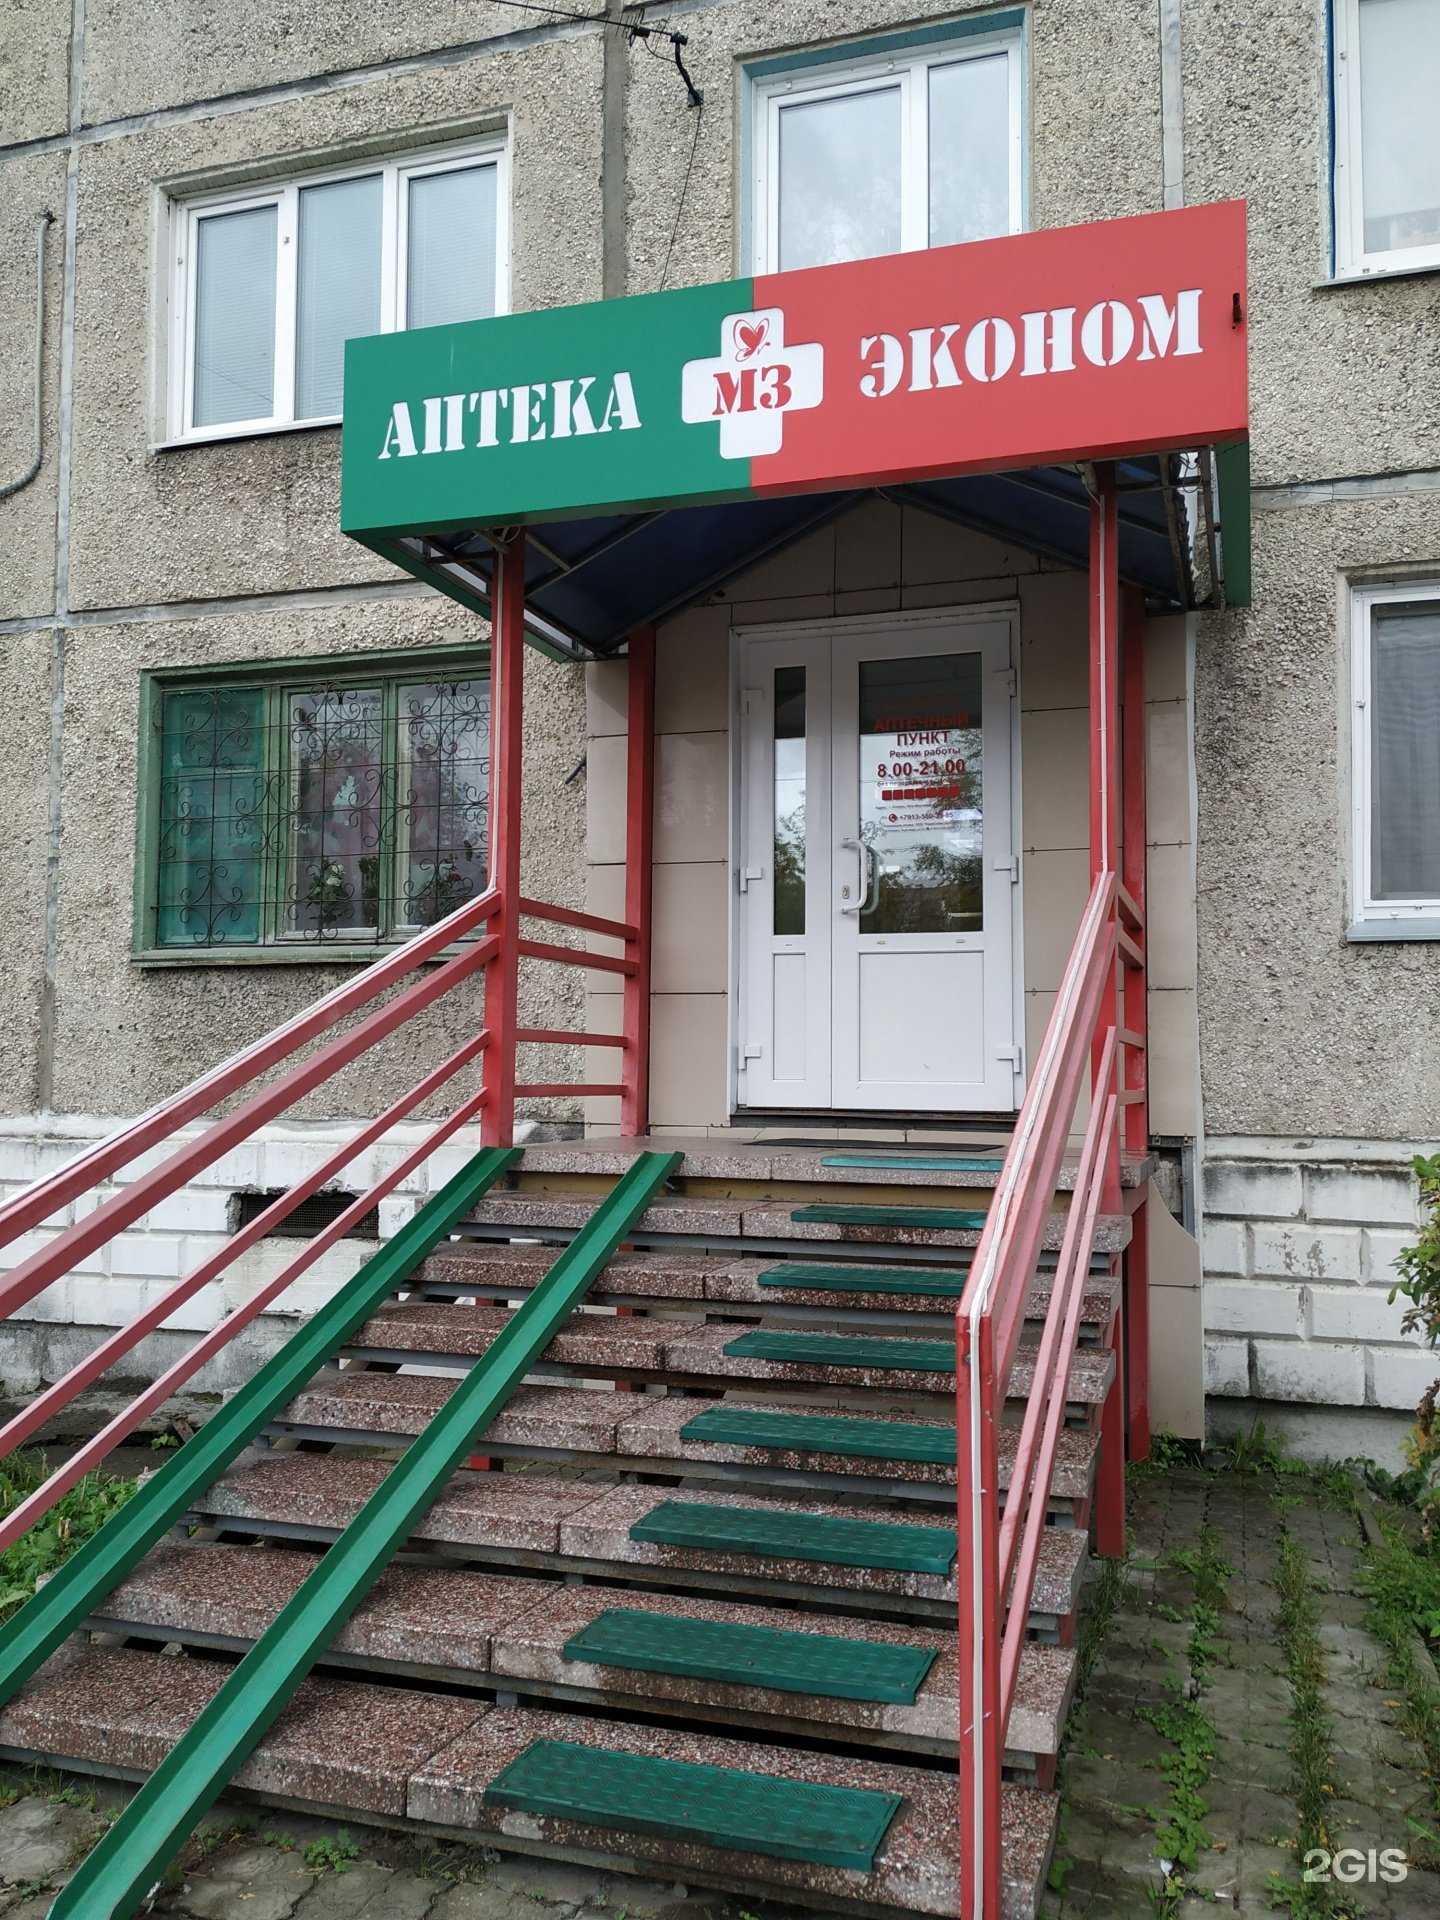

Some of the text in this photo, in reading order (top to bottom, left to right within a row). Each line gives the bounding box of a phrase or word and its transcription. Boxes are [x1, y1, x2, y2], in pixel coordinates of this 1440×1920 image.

[378, 371, 642, 460] АПТЕКА
[859, 288, 1204, 399] ЭКОНОМ
[897, 730, 951, 746] ПУНКТ
[889, 747, 960, 758] Режим работы
